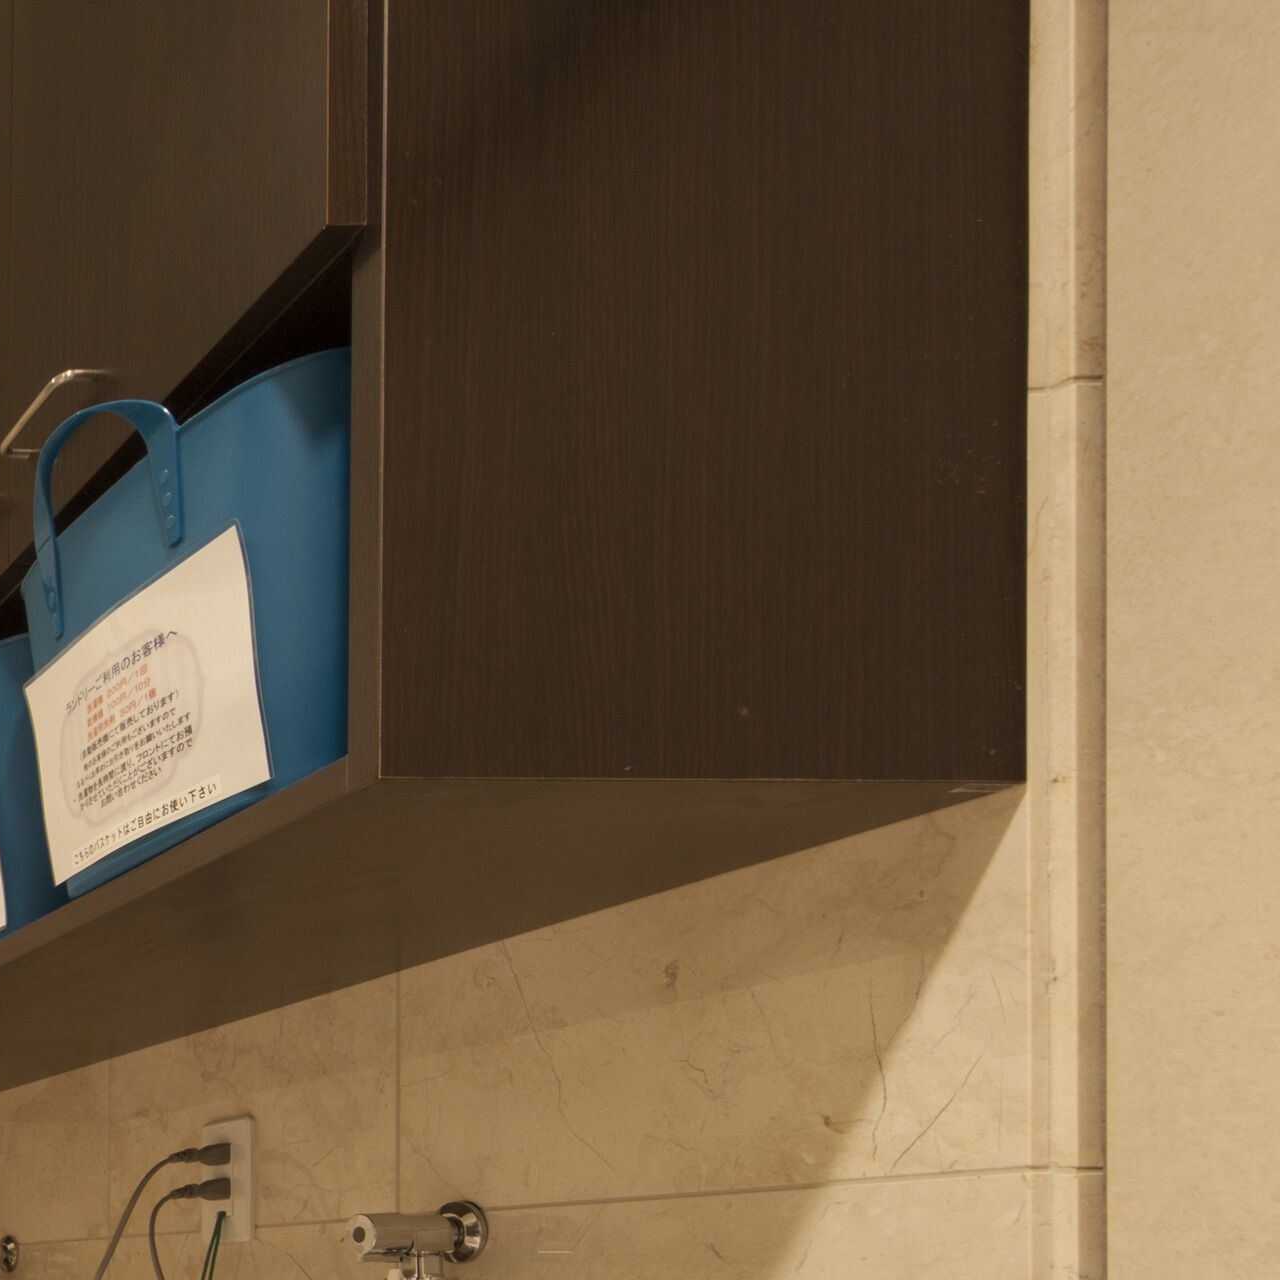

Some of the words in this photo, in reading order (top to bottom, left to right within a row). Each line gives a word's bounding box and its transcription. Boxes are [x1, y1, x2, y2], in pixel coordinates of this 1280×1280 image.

[65, 630, 178, 715] ランドリーご利用のお客様へ
[74, 783, 217, 864] こちらのバスケットはご自由にお使い下さい
